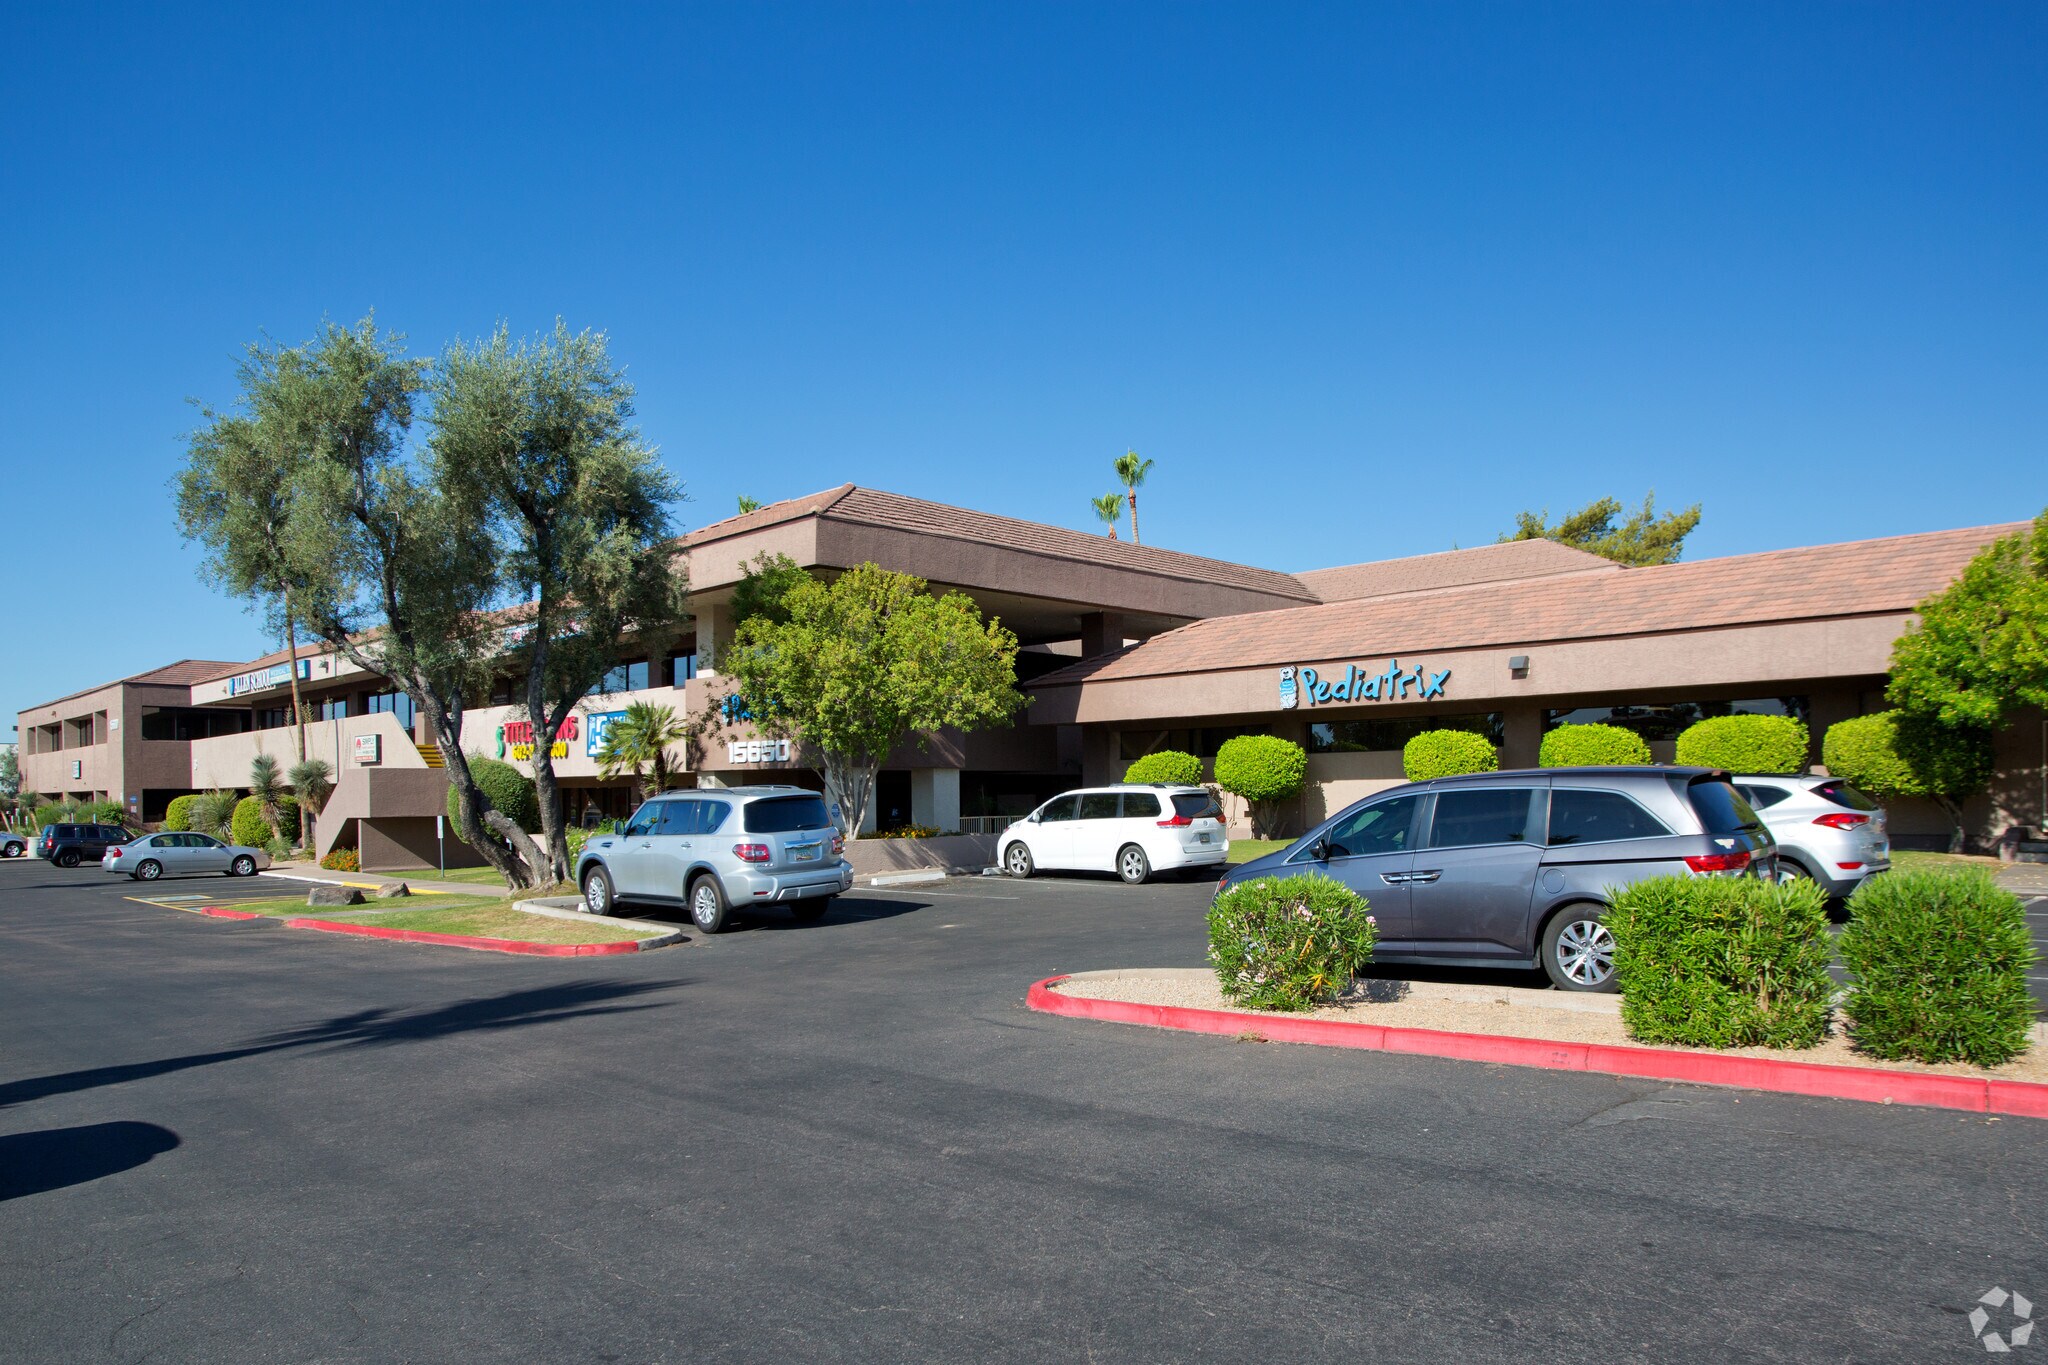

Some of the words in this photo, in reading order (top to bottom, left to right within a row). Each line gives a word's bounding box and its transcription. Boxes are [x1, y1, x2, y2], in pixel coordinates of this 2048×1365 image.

[1300, 658, 1451, 705] Pediatrix
[504, 720, 533, 744] TITLE
[728, 740, 790, 763] 15650
